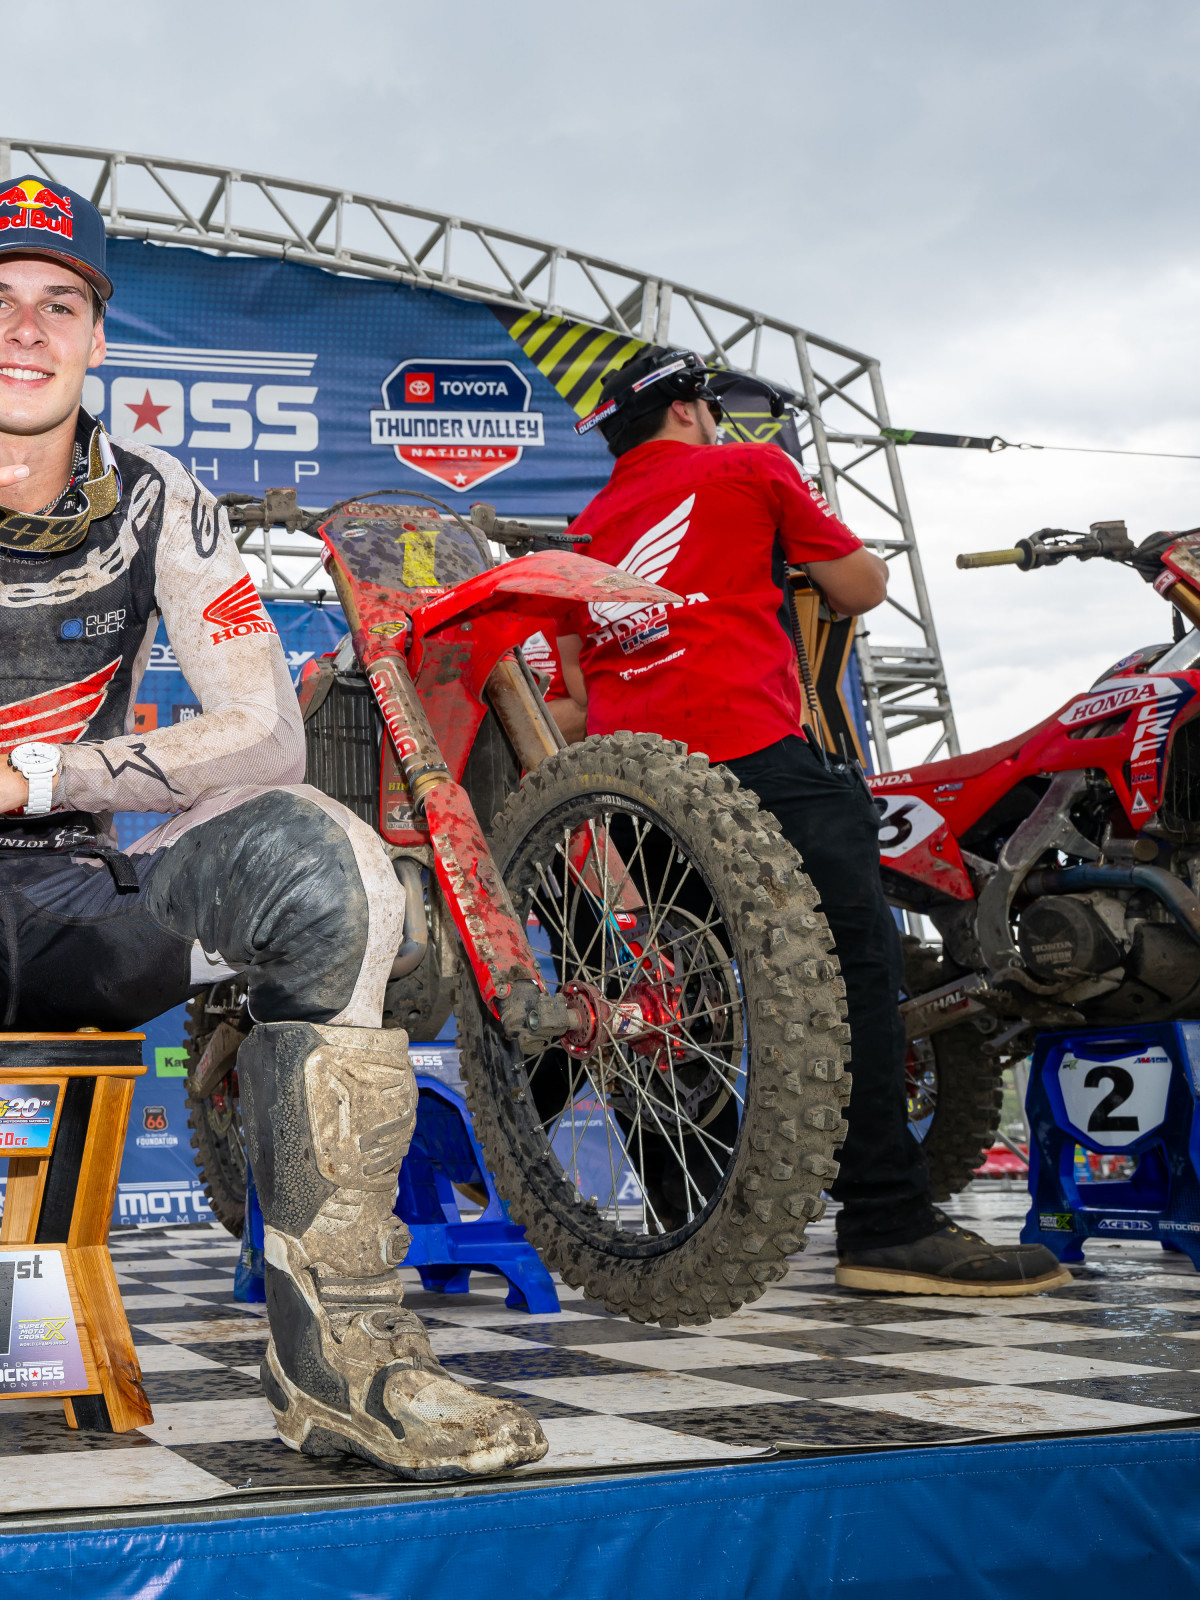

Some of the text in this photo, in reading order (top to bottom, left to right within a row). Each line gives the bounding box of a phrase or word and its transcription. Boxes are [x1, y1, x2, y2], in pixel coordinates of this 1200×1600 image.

[30, 209, 73, 240] Bull
[440, 381, 508, 396] TOYOTA
[375, 418, 539, 439] THUNDER VALLEY
[411, 448, 507, 458] NATIONAL
[395, 531, 441, 587] 1
[86, 609, 126, 626] QUAD
[85, 622, 125, 637] LOCK
[210, 621, 278, 646] HOND
[1070, 683, 1158, 721] HONDA
[1130, 698, 1178, 762] CRF
[866, 773, 913, 788] ONDA
[432, 833, 496, 958] DUNLOP
[1084, 1065, 1140, 1132] 2
[146, 1115, 165, 1129] 66
[136, 1137, 178, 1146] FOUNDATION
[1159, 1223, 1200, 1232] MOTOCRO
